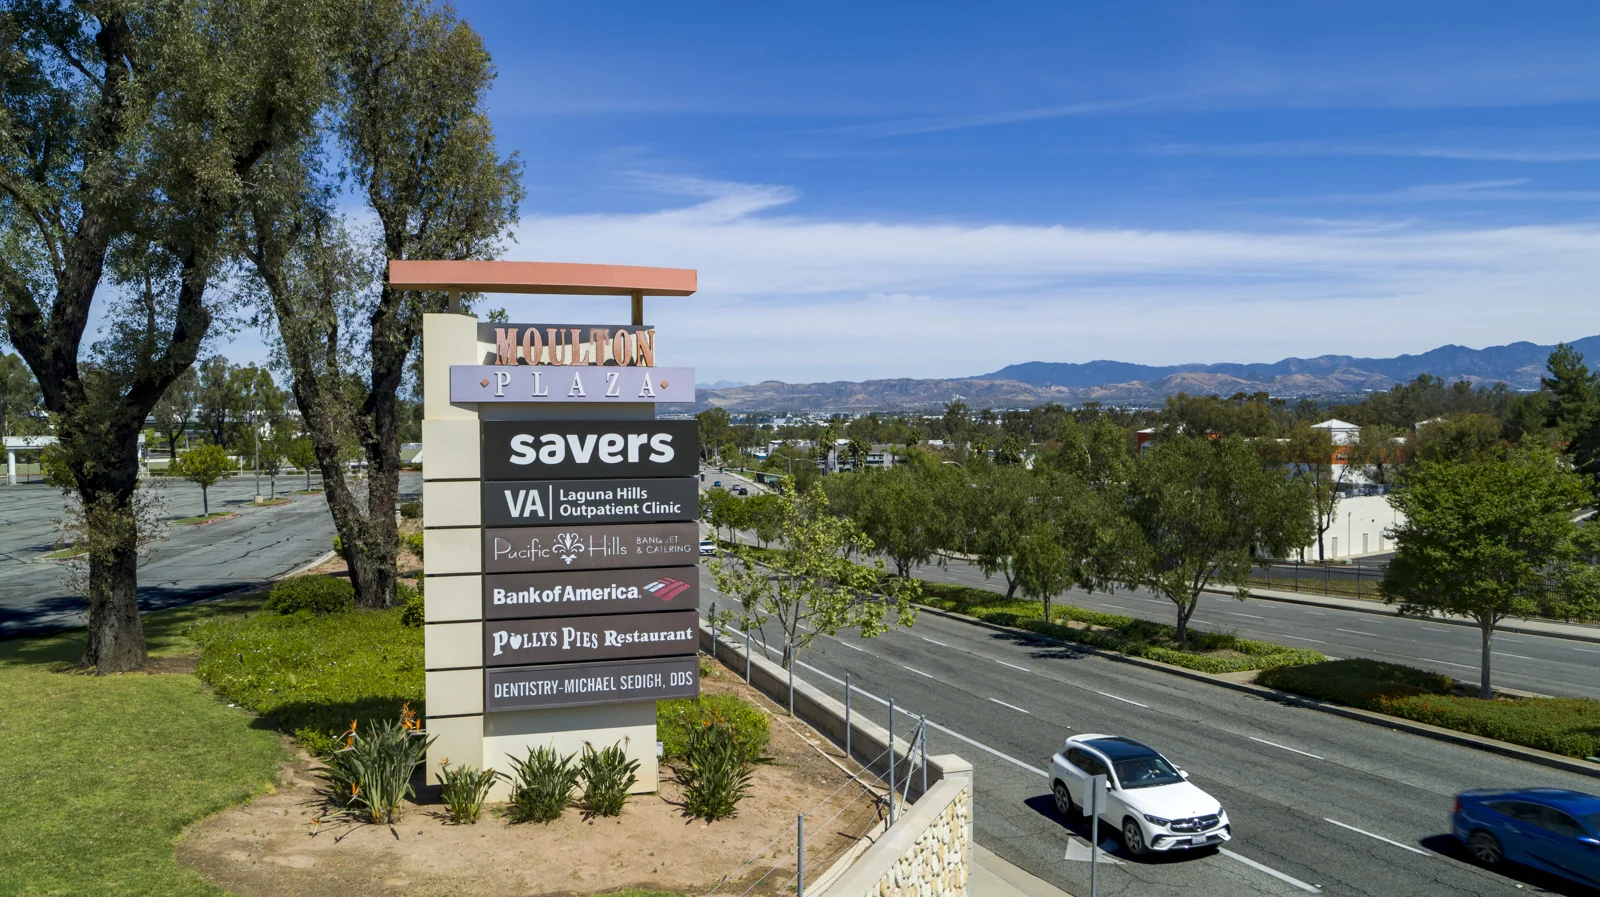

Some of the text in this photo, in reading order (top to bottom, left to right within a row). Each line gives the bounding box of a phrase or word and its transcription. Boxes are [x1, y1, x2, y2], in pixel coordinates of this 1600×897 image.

[494, 327, 656, 367] MOULTON
[494, 371, 657, 398] PLAZA
[509, 432, 675, 465] savers
[504, 489, 545, 518] VA
[560, 486, 648, 503] Laguna Hills
[560, 501, 681, 518] Outpatient Clinic
[494, 535, 628, 561] Pacific Hills
[636, 535, 679, 545] BANQET
[636, 544, 692, 554] & CATERING
[561, 626, 599, 650] PIES
[604, 627, 693, 647] Restaurant
[620, 673, 666, 690] SEDIGH,
[670, 671, 693, 687] DDS
